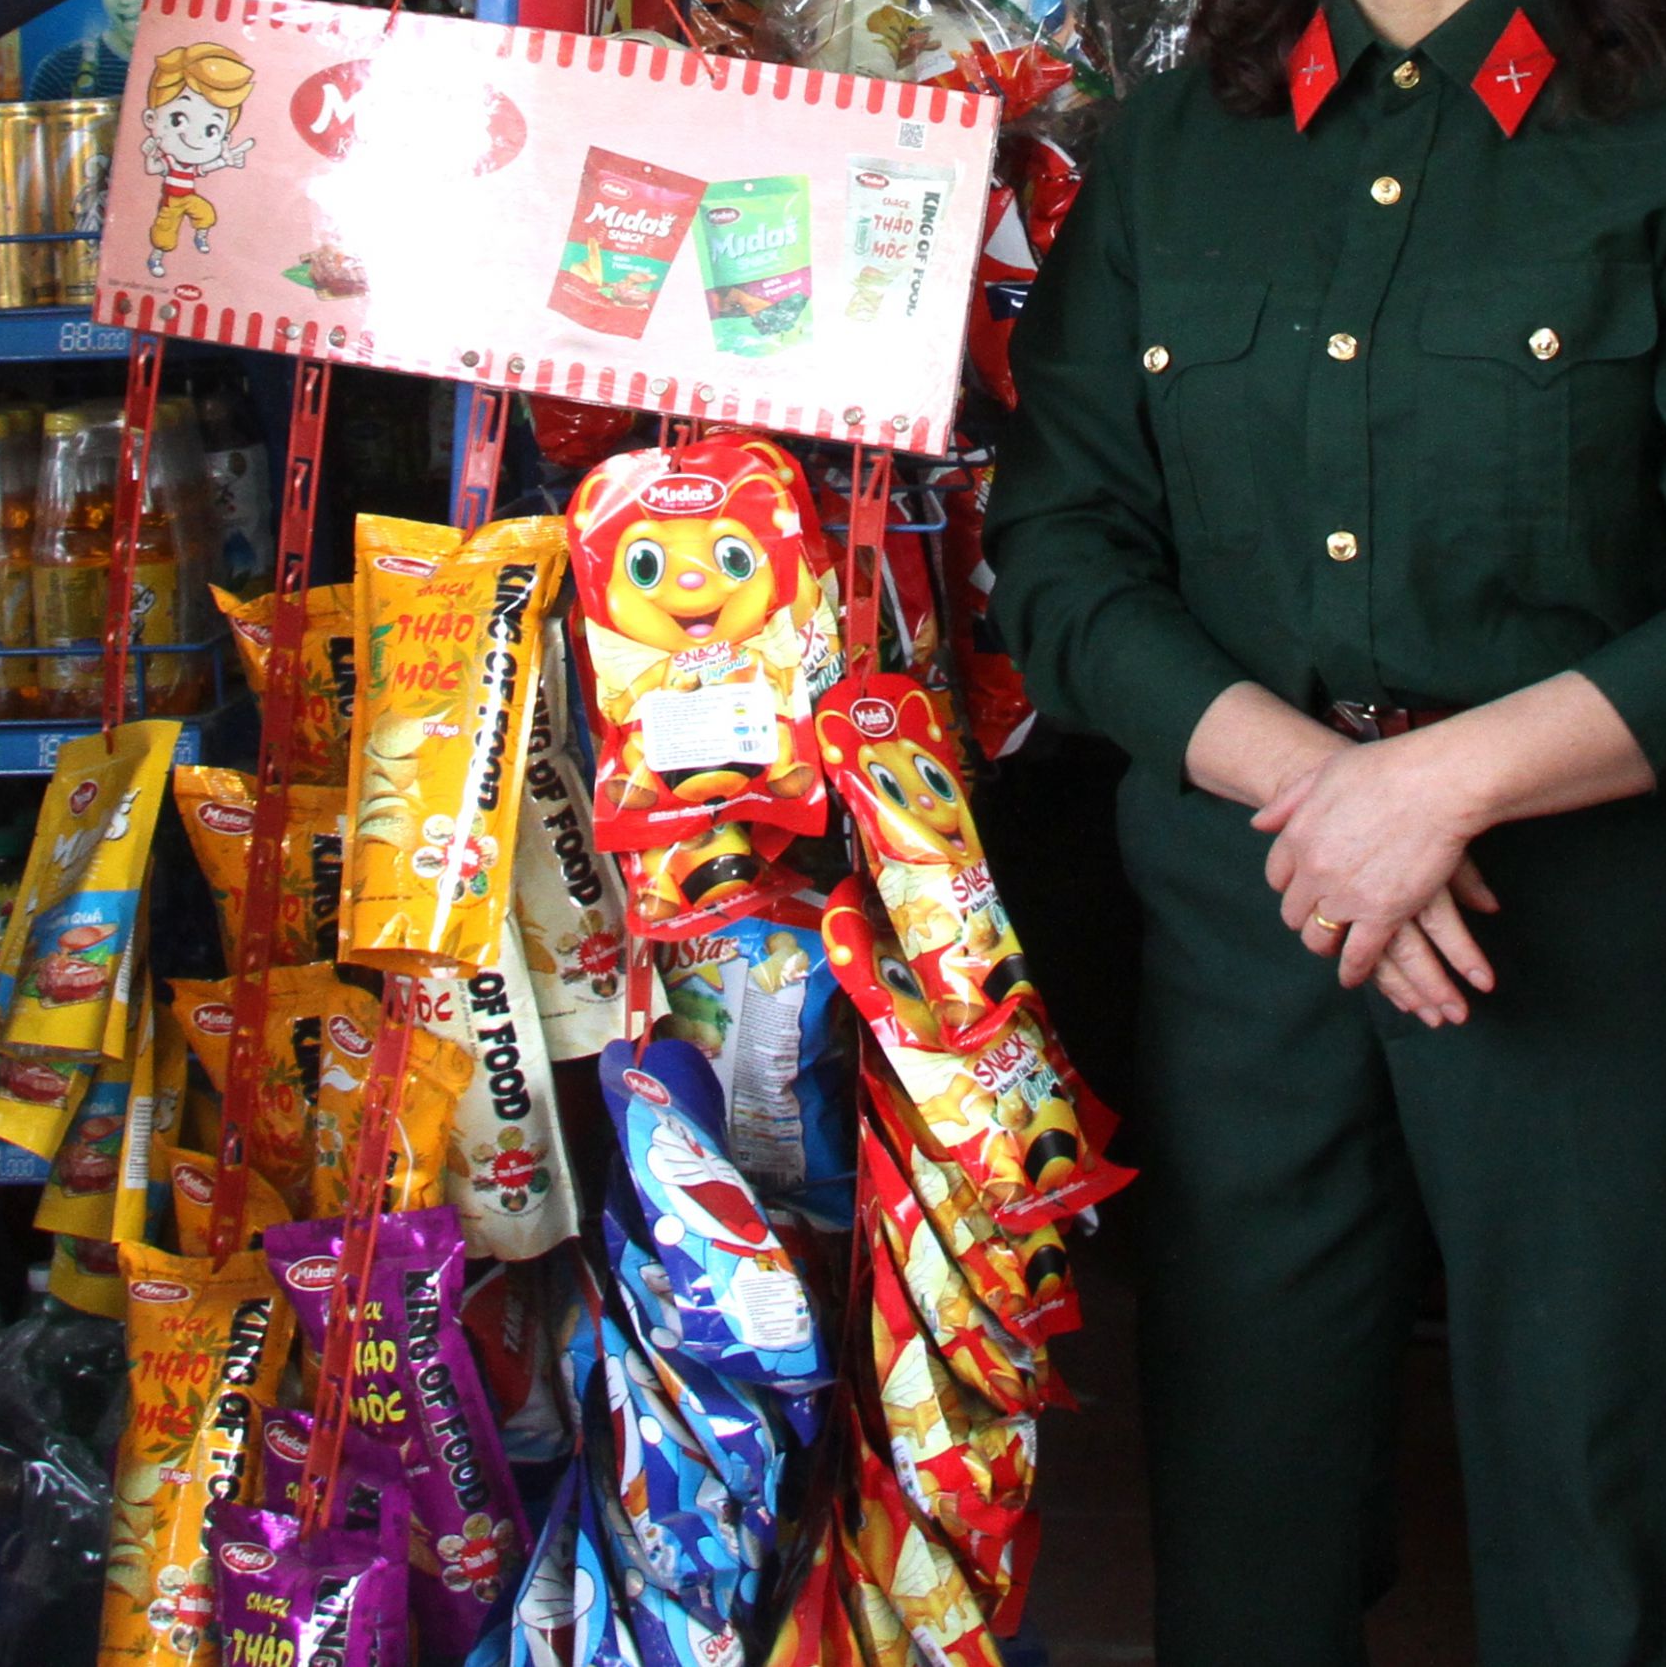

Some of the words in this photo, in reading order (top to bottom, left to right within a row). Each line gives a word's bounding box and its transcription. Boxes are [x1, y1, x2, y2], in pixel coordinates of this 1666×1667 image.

[585, 202, 676, 238] Midas
[872, 211, 913, 235] THẢO
[917, 190, 941, 236] KING
[608, 228, 645, 244] SNACK
[712, 216, 798, 261] Midas
[916, 239, 931, 264] OF
[648, 483, 714, 503] Midas
[416, 581, 473, 598] SNACK
[487, 563, 537, 645] KING
[396, 602, 475, 644] THẢO
[674, 641, 729, 667] SNACK
[699, 654, 749, 684] Organic
[527, 759, 568, 803] OF
[543, 805, 603, 908] FOOD
[469, 972, 510, 1015] OF
[478, 1021, 531, 1121] FOOD
[974, 1033, 1030, 1088] SNACK
[135, 1282, 182, 1297] Midas
[405, 1271, 441, 1365] KING
[222, 1297, 273, 1386] KING
[417, 1367, 459, 1412] OF
[433, 1418, 489, 1514] FOOD
[231, 1548, 272, 1566] Midas
[246, 1591, 290, 1618] SNACK
